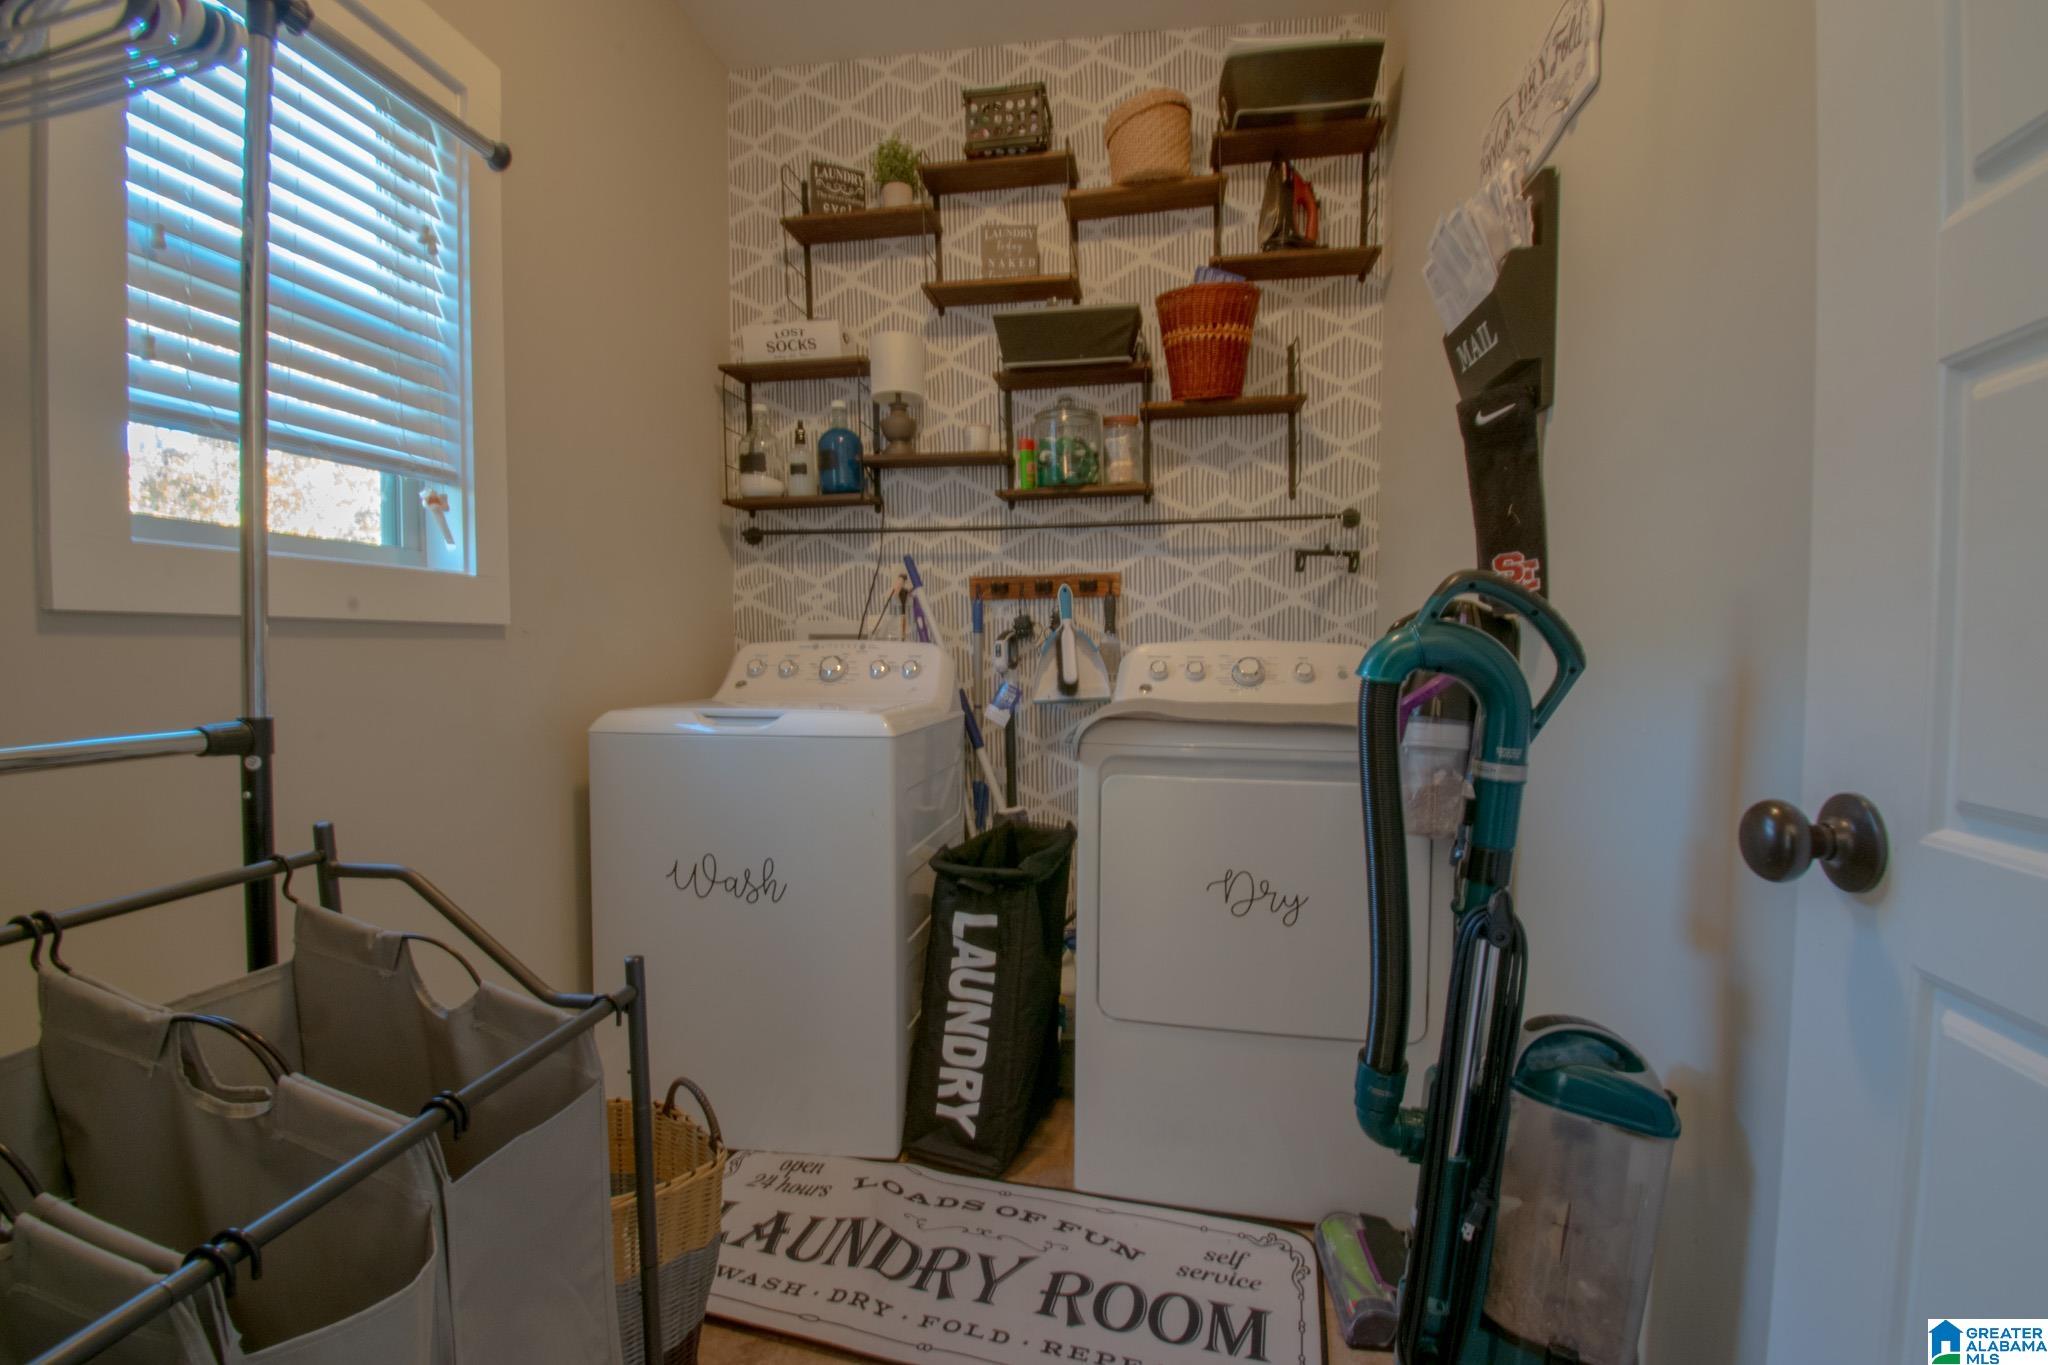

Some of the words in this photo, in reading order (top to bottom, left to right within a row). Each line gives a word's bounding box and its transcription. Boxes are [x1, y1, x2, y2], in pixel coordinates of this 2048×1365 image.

[814, 165, 864, 188] LAUNDRY
[984, 227, 1034, 241] LAUNDRY
[987, 256, 1036, 268] NAKED
[766, 337, 817, 353] SOCKS
[774, 327, 806, 340] LOST
[1455, 320, 1499, 374] MAIL
[665, 852, 787, 904] Wash
[1206, 868, 1309, 927] Dry
[935, 911, 999, 1141] LAUNDRY
[779, 1158, 825, 1177] open
[746, 1172, 775, 1189] 24
[775, 1174, 834, 1199] hours
[852, 1175, 987, 1213] LOADS
[995, 1204, 1048, 1226] OF
[1053, 1218, 1147, 1262] FUN
[1203, 1248, 1252, 1271] self
[1176, 1264, 1264, 1292] service
[716, 1264, 808, 1298] WASH
[827, 1287, 895, 1321] DRY
[916, 1313, 1011, 1345] FOLD
[1034, 1269, 1274, 1363] ROOM
